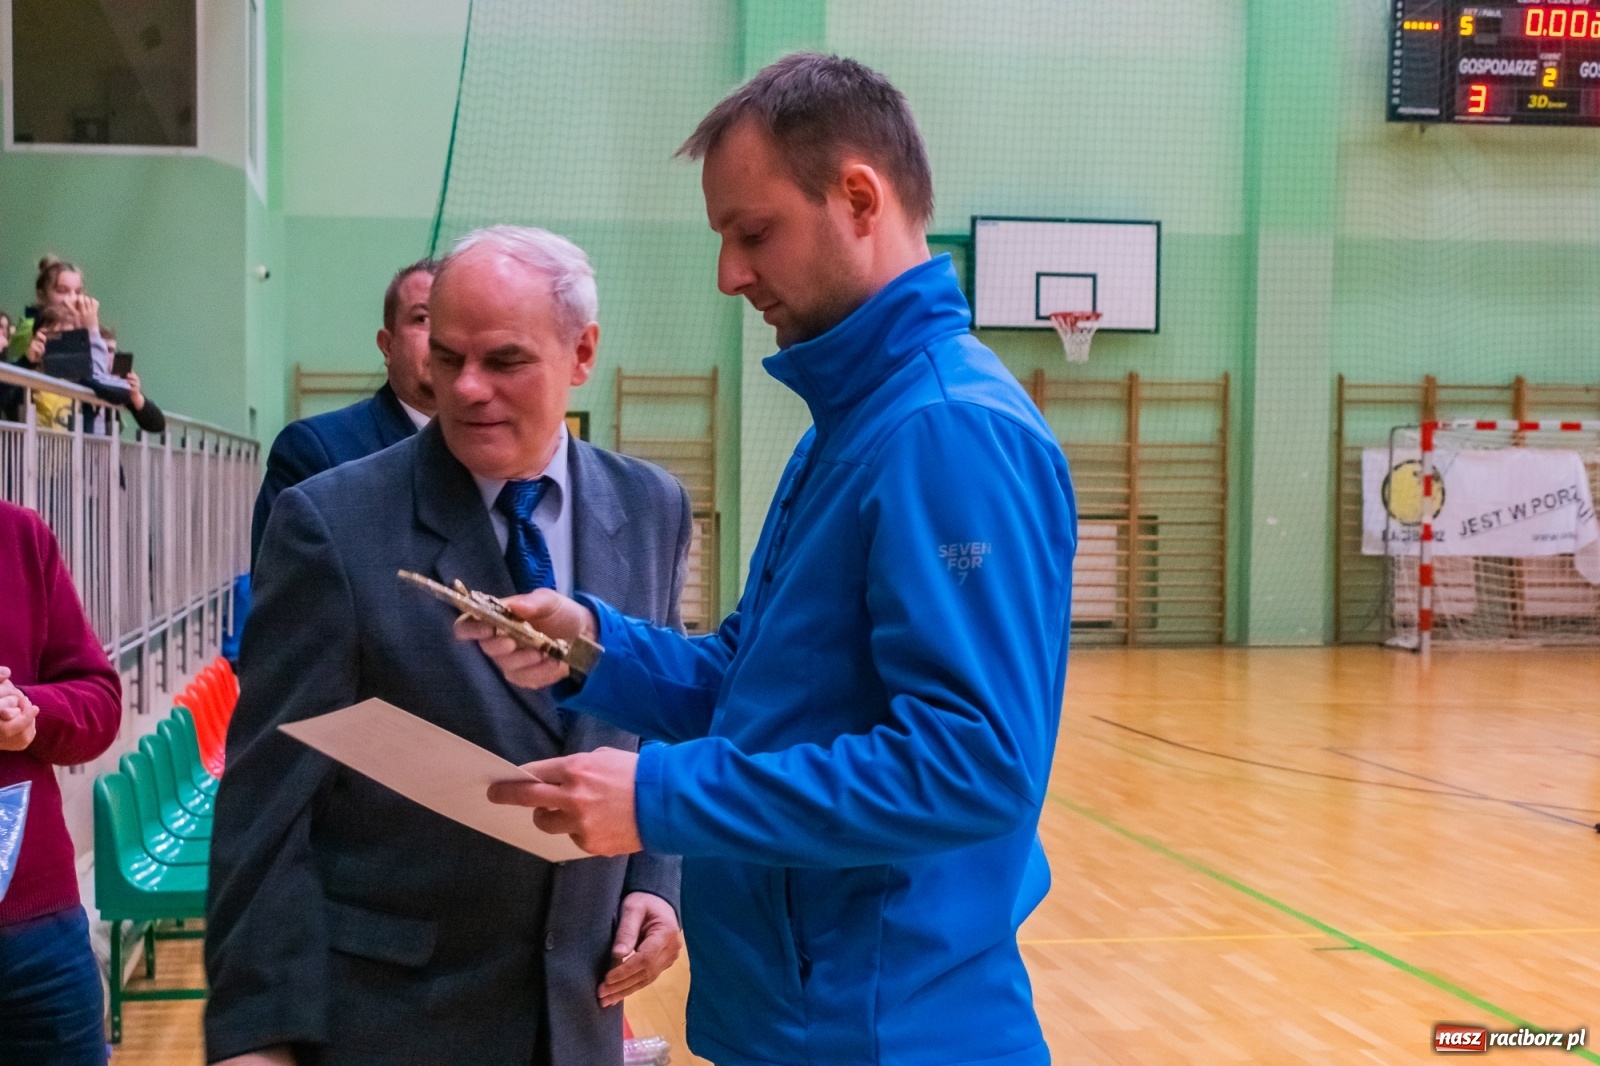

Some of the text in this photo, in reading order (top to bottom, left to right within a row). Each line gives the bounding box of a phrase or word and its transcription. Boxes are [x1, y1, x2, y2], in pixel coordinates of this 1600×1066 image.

[1459, 15, 1475, 36] 5
[1459, 57, 1538, 76] GOSPODARZE
[1542, 67, 1558, 87] 2
[1468, 84, 1487, 113] 3
[1459, 510, 1503, 537] JEST
[1508, 501, 1527, 521] W
[938, 541, 992, 558] SEVEN
[947, 556, 983, 571] FOR
[958, 571, 969, 587] 7
